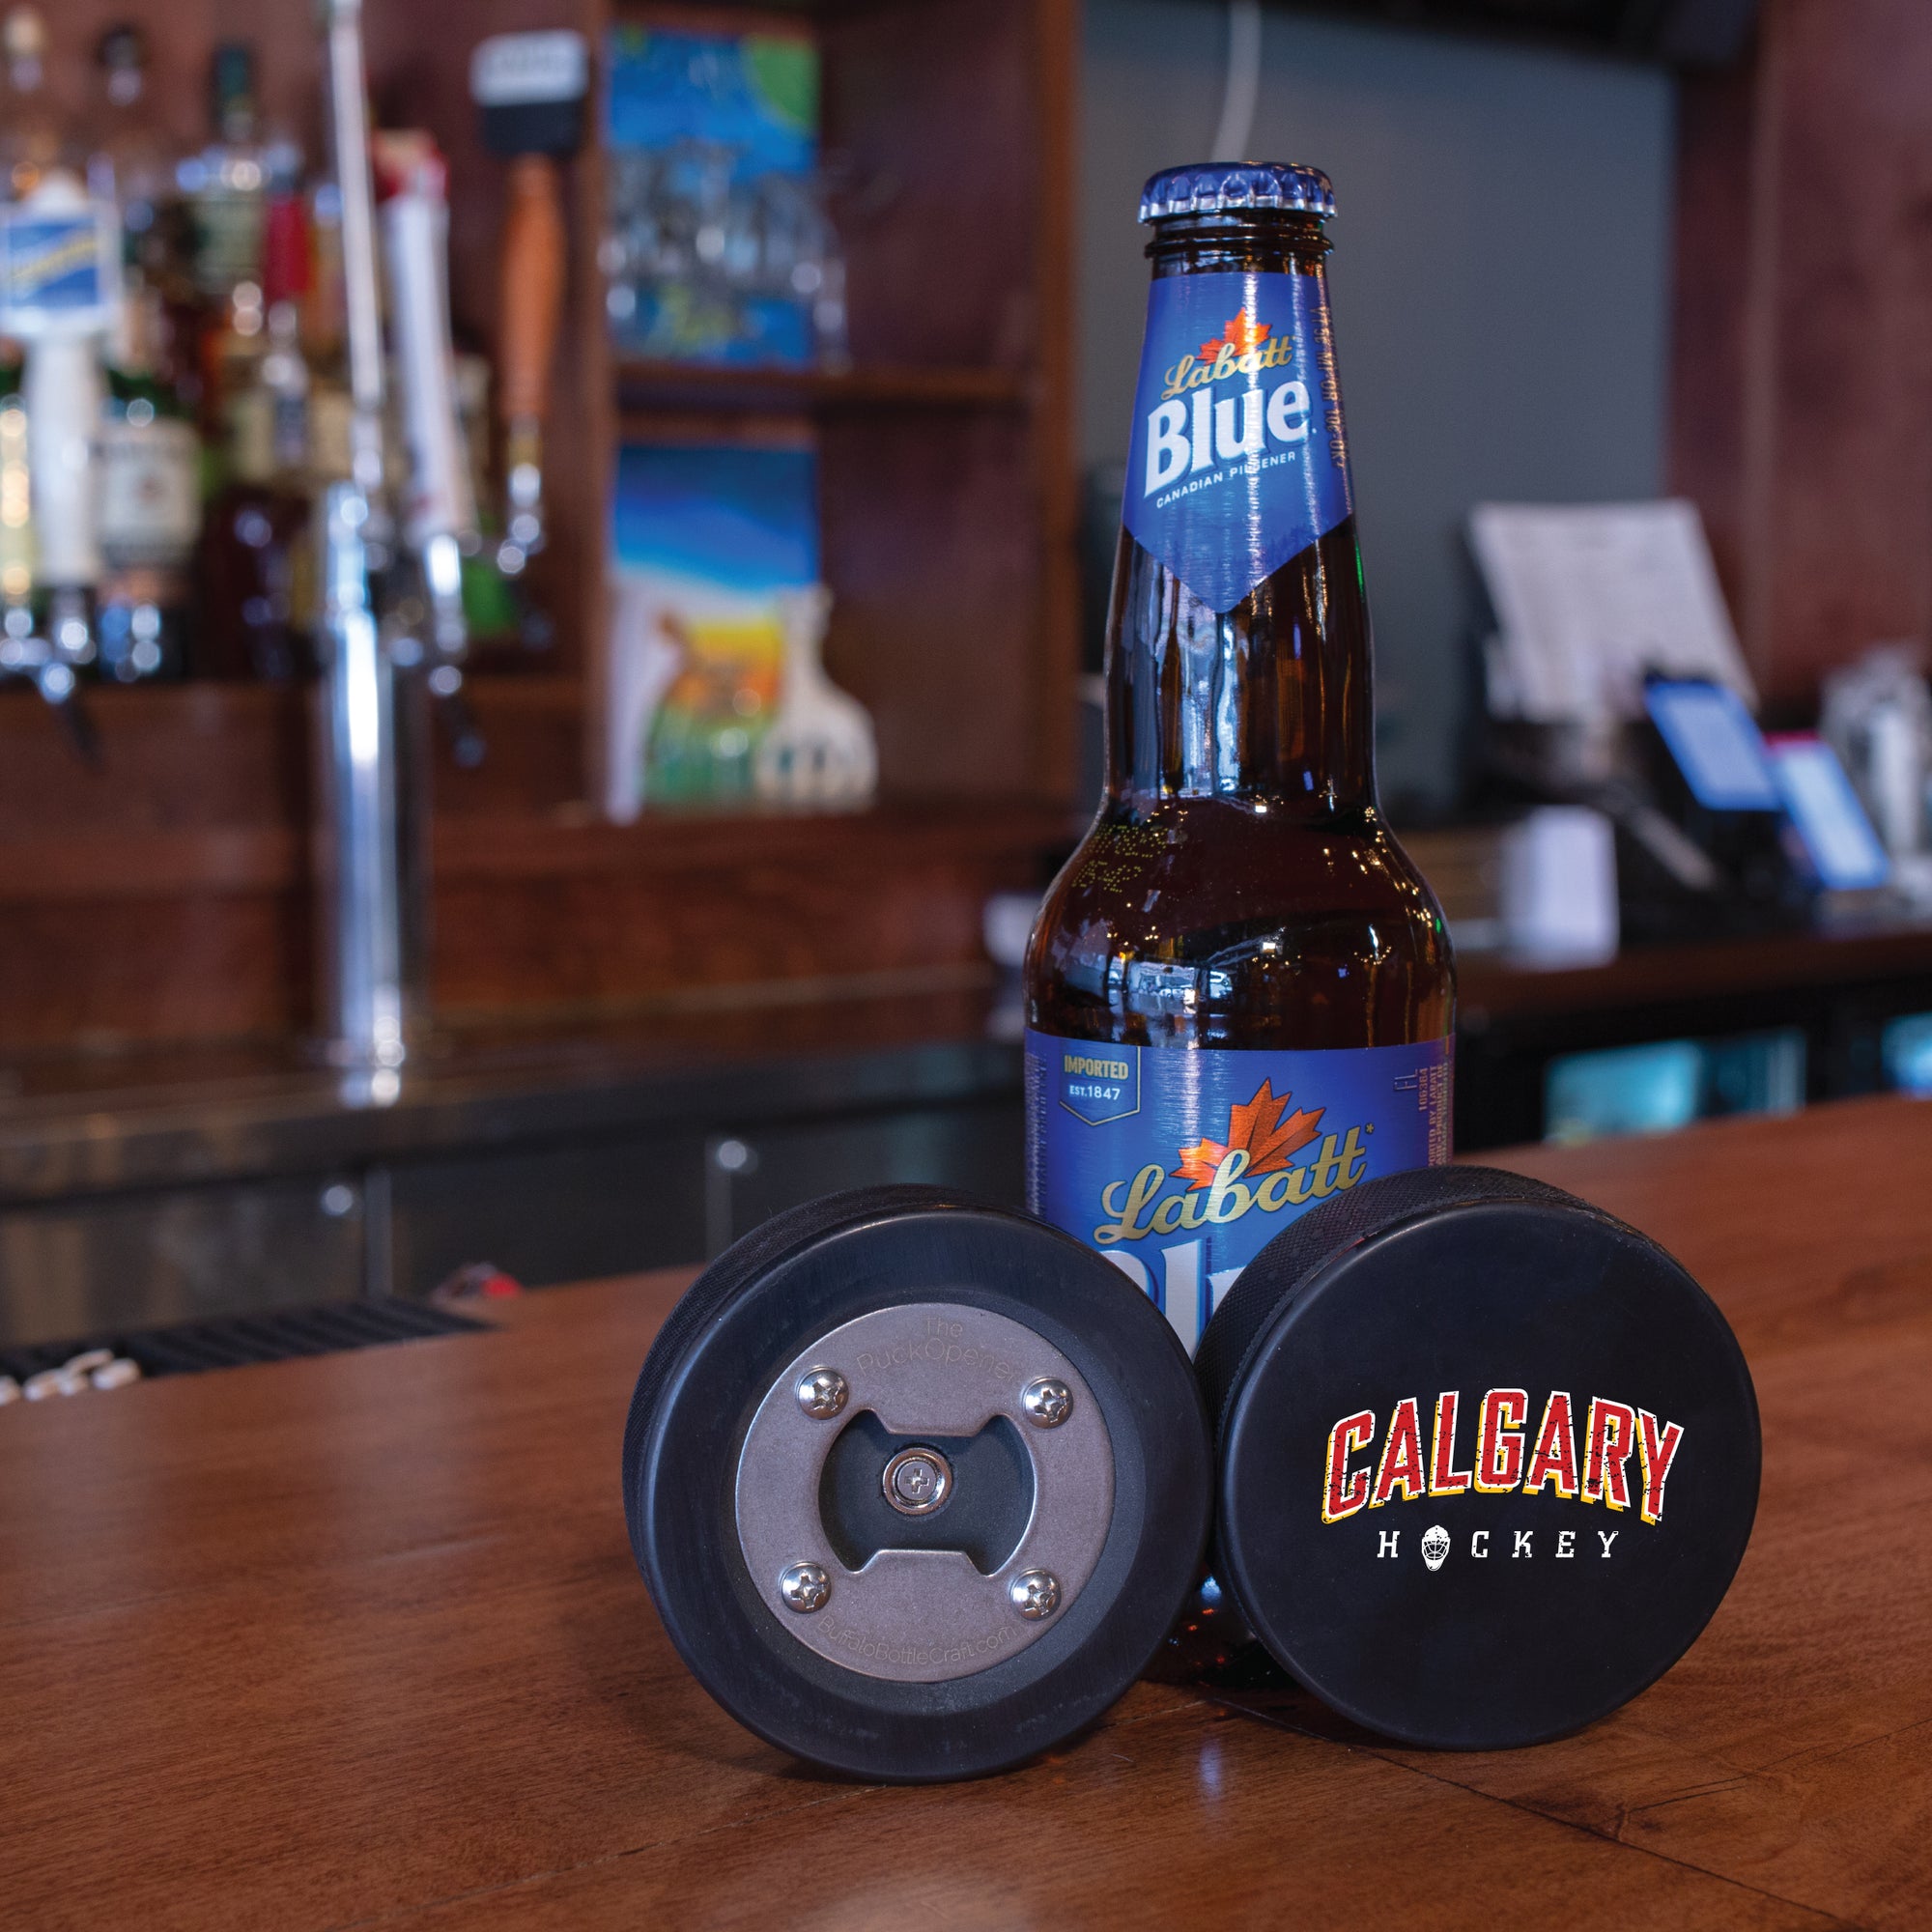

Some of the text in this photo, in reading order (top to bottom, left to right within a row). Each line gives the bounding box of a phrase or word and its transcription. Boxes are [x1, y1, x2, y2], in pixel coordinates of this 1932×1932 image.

[1161, 335, 1292, 400] Labatt
[1144, 381, 1310, 498] Blue
[1156, 451, 1295, 509] CANADIAN PILSENER
[1065, 1055, 1128, 1080] IMPORTED
[1094, 1126, 1366, 1244] Labatt
[925, 1316, 963, 1338] The
[1321, 1387, 1685, 1526] CALGARY
[1377, 1524, 1619, 1572] HCKEY
